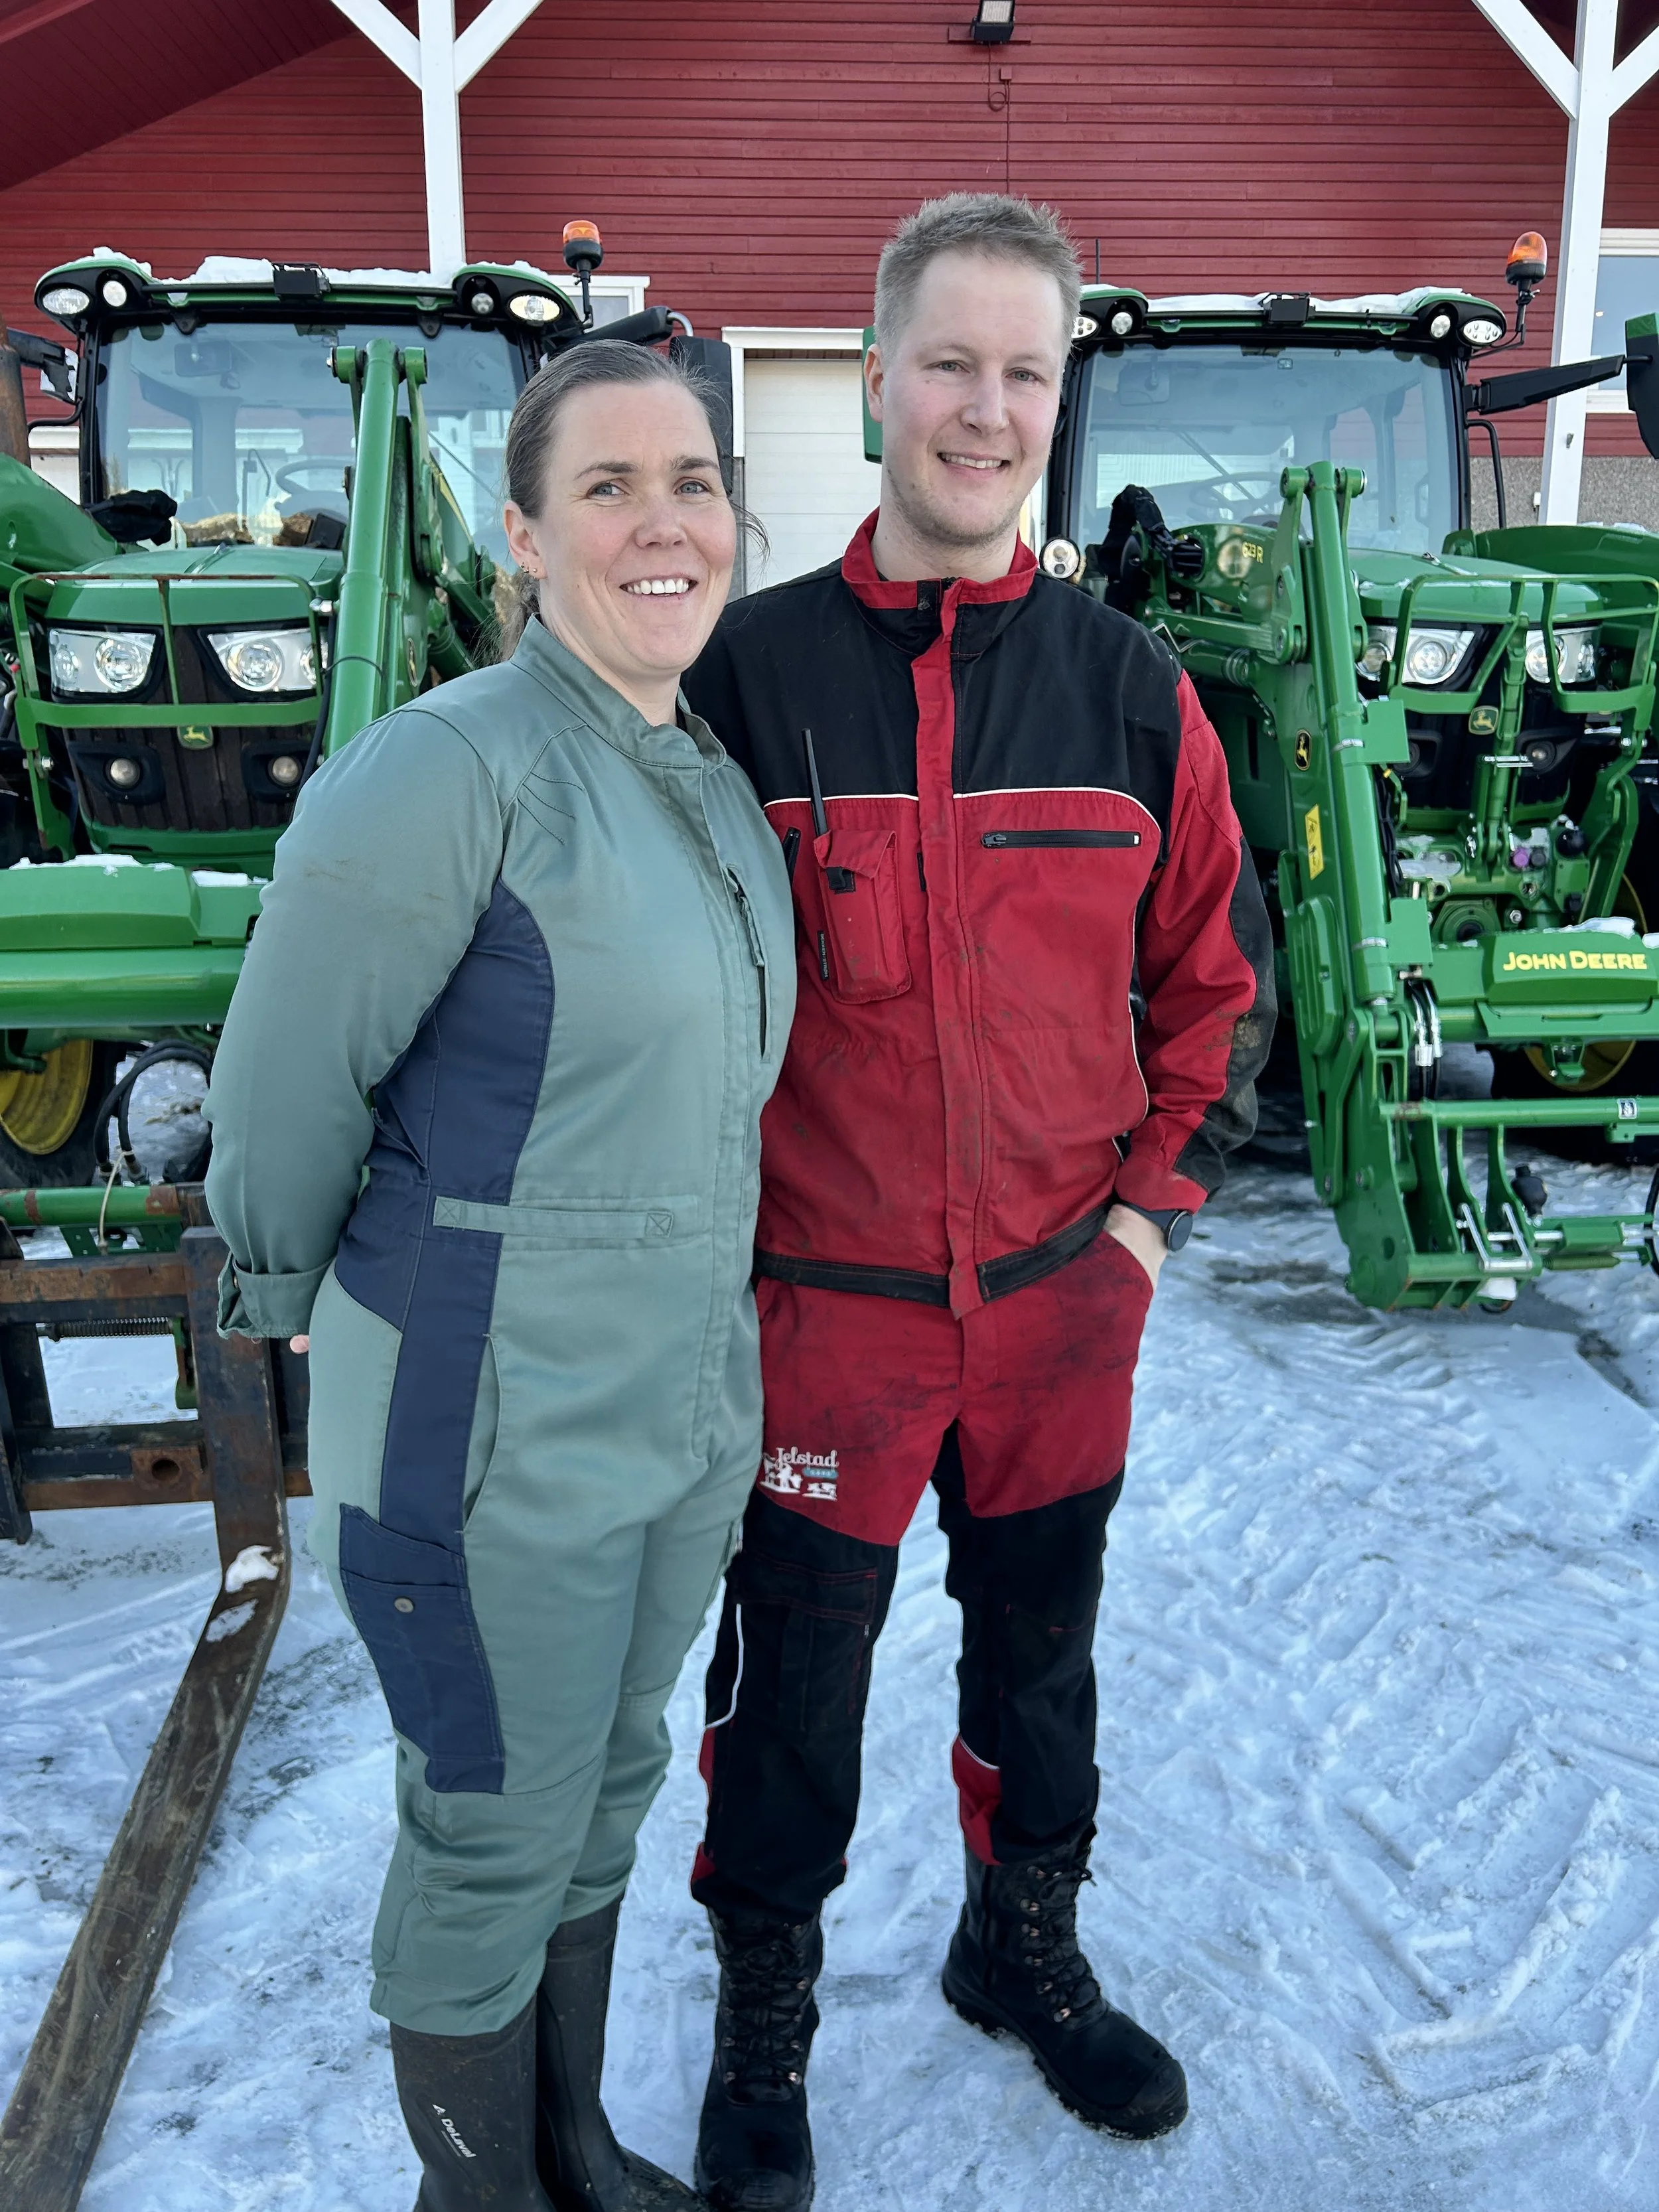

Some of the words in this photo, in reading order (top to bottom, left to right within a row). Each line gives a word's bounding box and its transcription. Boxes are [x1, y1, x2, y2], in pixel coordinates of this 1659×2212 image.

[1502, 951, 1567, 971] JOHN
[1569, 950, 1647, 970] DEERE
[441, 2118, 476, 2158] DeLaval
